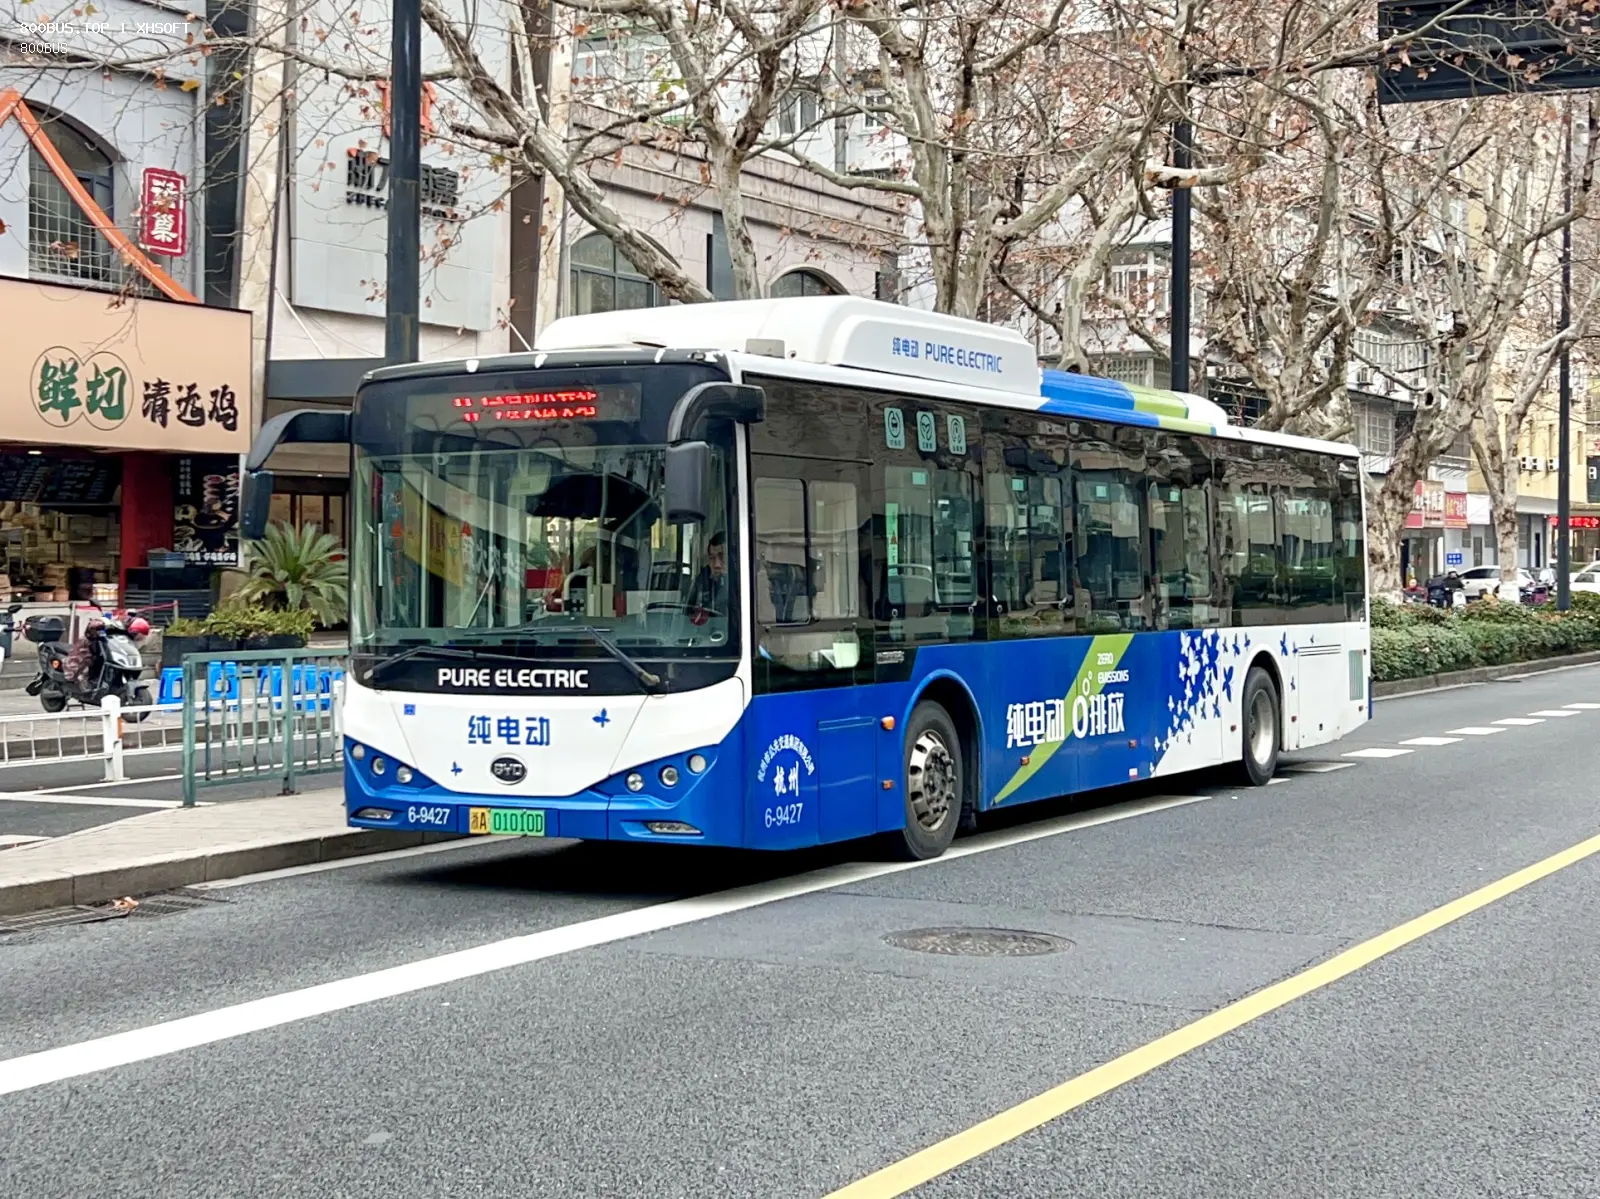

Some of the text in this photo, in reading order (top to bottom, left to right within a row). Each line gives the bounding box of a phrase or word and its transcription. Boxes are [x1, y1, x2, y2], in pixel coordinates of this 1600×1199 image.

[892, 336, 1003, 373] 纯电动 PURE ELECTRIC
[39, 355, 238, 432] 鲜切 清远鸡
[438, 668, 589, 689] PURE ELECTRIC
[468, 715, 550, 746] 纯电动
[1006, 699, 1065, 748] 纯电动
[408, 806, 450, 825] 6-9427
[765, 803, 803, 828] 6-9427
